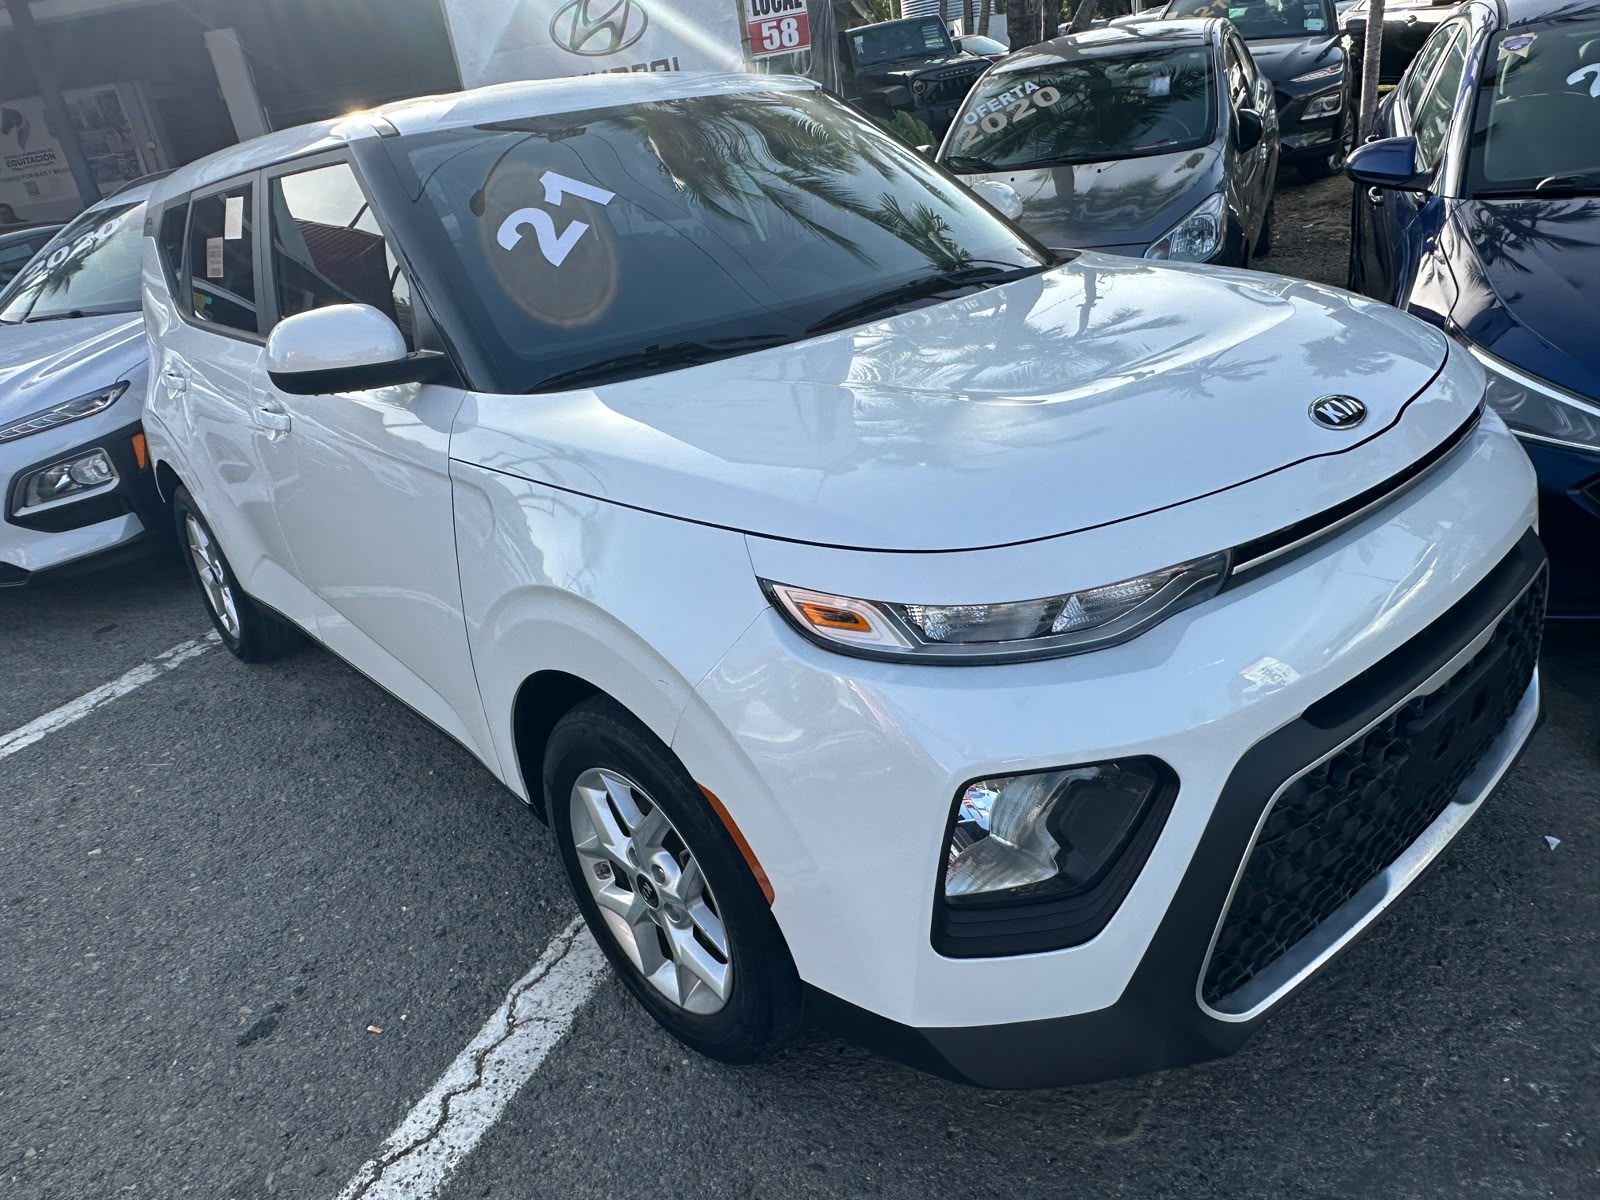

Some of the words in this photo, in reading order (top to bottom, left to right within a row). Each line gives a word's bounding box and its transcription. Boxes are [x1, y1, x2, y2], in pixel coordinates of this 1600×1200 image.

[761, 18, 799, 50] 58
[958, 86, 1060, 150] 2020
[963, 81, 1041, 124] OFERTA
[497, 171, 616, 267] 21
[1316, 399, 1364, 424] KIA
